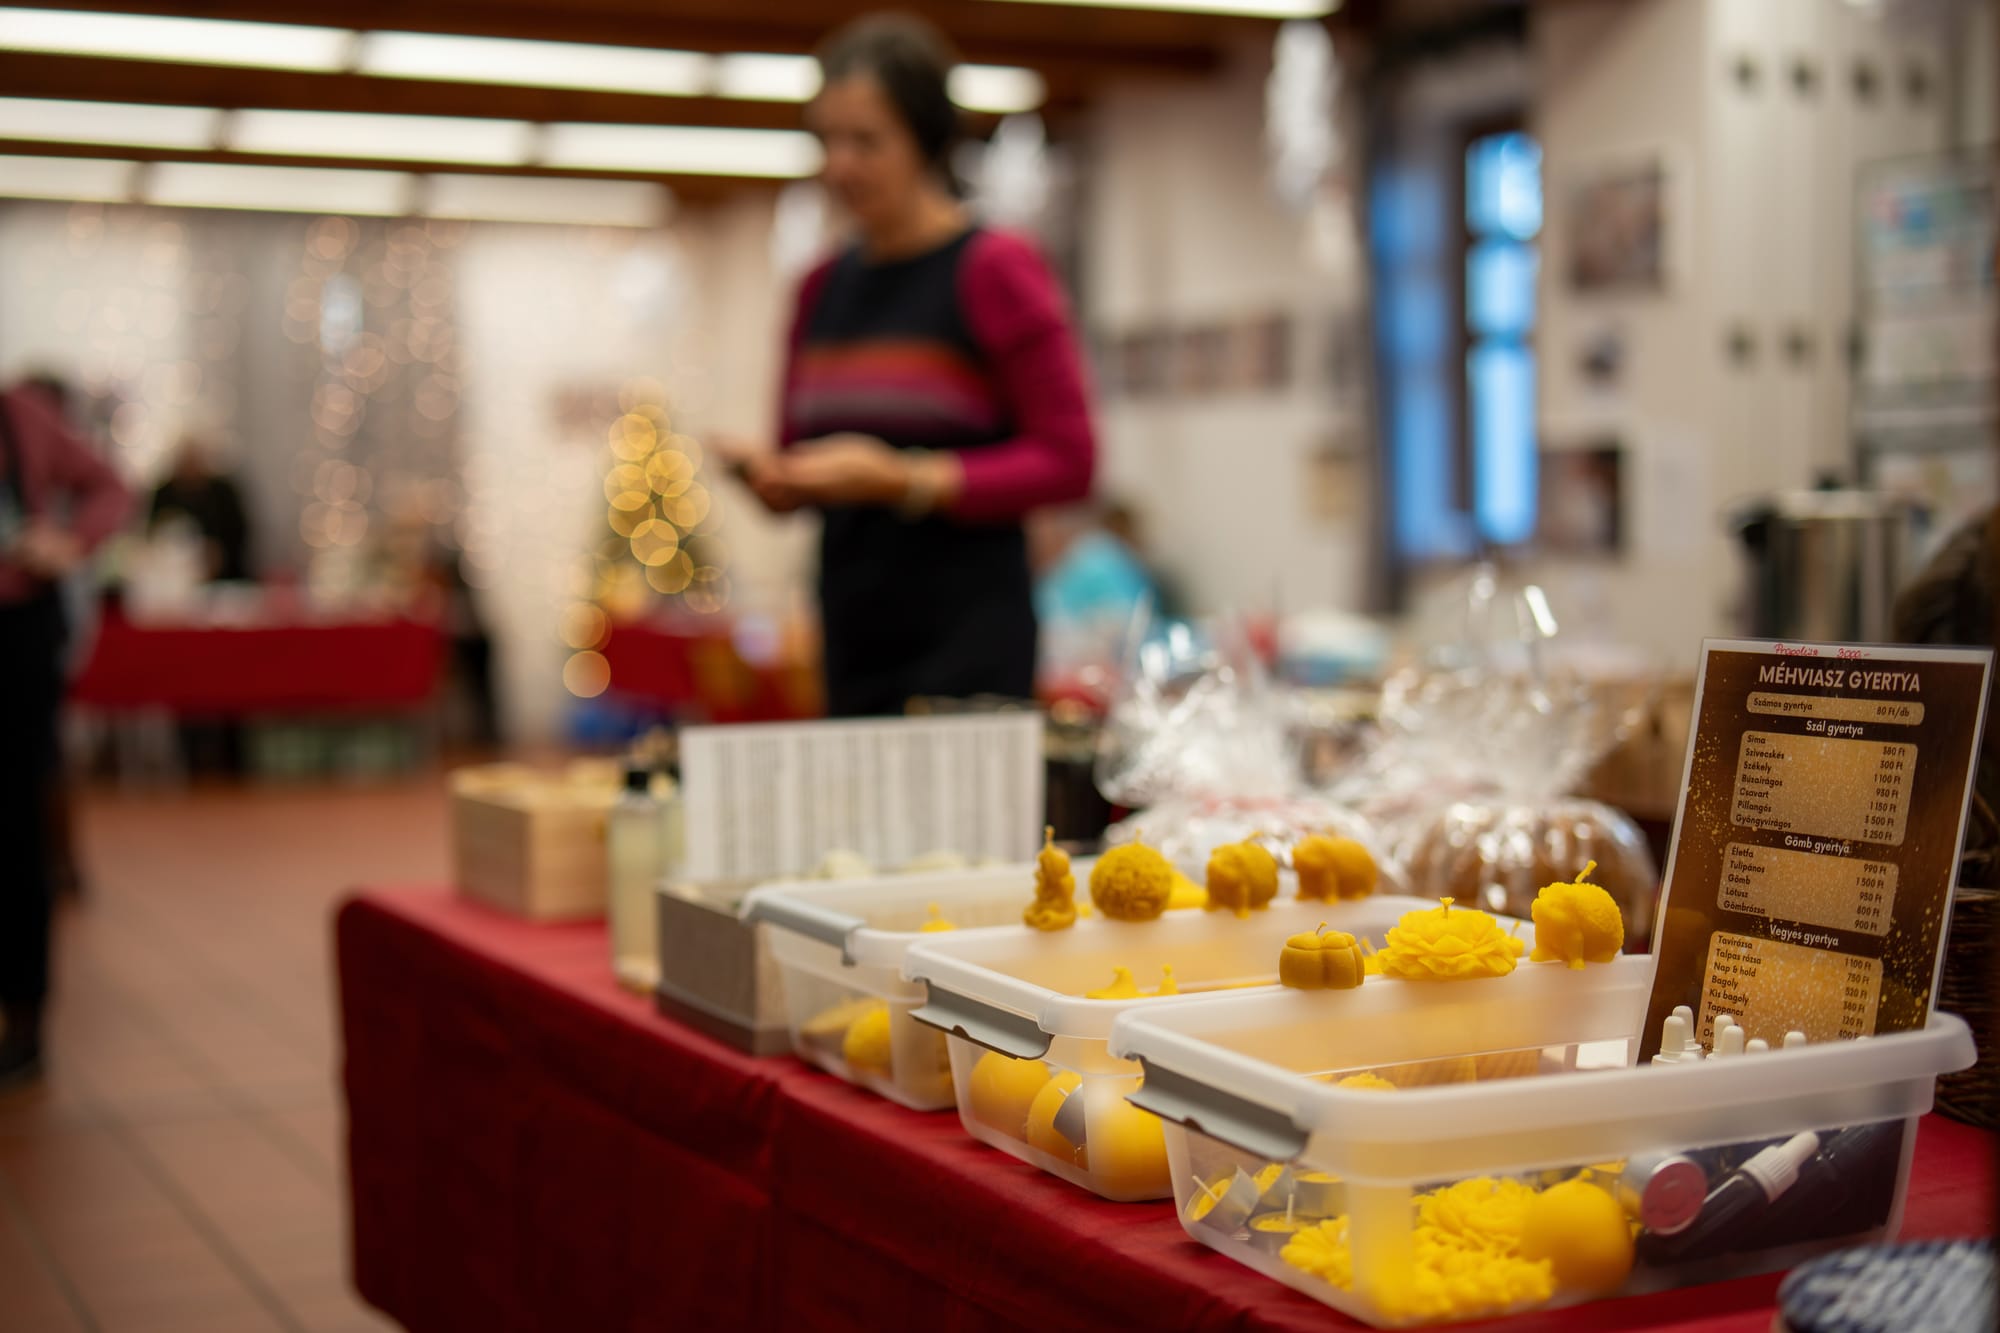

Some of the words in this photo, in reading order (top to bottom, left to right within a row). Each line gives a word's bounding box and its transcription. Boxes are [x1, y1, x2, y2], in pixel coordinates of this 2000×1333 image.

[1759, 662, 1845, 688] MÉHVIASZ
[1849, 671, 1920, 692] GYERTYA
[1753, 698, 1781, 708] Számos
[1783, 702, 1812, 712] gyertya
[1876, 706, 1886, 716] 80
[1806, 720, 1826, 732] Szál
[1827, 724, 1864, 738] gyertya
[1747, 735, 1766, 744] Sima
[1898, 747, 1905, 757] Ft
[1743, 761, 1772, 774] Székely
[1893, 775, 1901, 785] Ft
[1896, 761, 1903, 771] Ft
[1740, 788, 1769, 798] Csavart
[1889, 803, 1896, 813] Ft
[1891, 789, 1899, 799] Ft
[1735, 814, 1792, 829] Gyöngyvirágos
[1885, 831, 1892, 840] Ft
[1737, 800, 1772, 814] Pillangós
[1887, 817, 1894, 827] Ft
[1784, 835, 1812, 849] Gömb
[1814, 842, 1850, 856] gyertya
[1731, 845, 1754, 858] Életfa
[1864, 864, 1878, 874] 990
[1879, 865, 1887, 875] Ft
[1728, 873, 1751, 885] Gömb
[1874, 893, 1882, 903] Ft
[1730, 861, 1765, 873] Tulipános
[1876, 879, 1884, 889] Ft
[1723, 900, 1765, 914] Gömbrózsa
[1854, 919, 1869, 930] 900
[1870, 922, 1878, 931] Ft
[1726, 887, 1748, 898] Lótusz
[1872, 907, 1880, 917] Ft
[1770, 924, 1802, 940] Vegyes
[1803, 932, 1839, 948] gyertya
[1716, 948, 1740, 961] Talpas
[1742, 954, 1761, 964] rózsa
[1862, 975, 1870, 985] Ft
[1718, 935, 1753, 949] Tavirózsa
[1864, 960, 1872, 971] Ft
[1711, 975, 1739, 990] Bagoly
[1857, 1003, 1865, 1014] Ft
[1713, 962, 1731, 973] Nap
[1740, 966, 1756, 977] hold
[1860, 989, 1868, 1000] Ft
[1707, 1002, 1744, 1016] Tappancs
[1709, 988, 1721, 998] Kis
[1722, 990, 1749, 1007] bagoly
[1856, 1018, 1863, 1028] Ft
